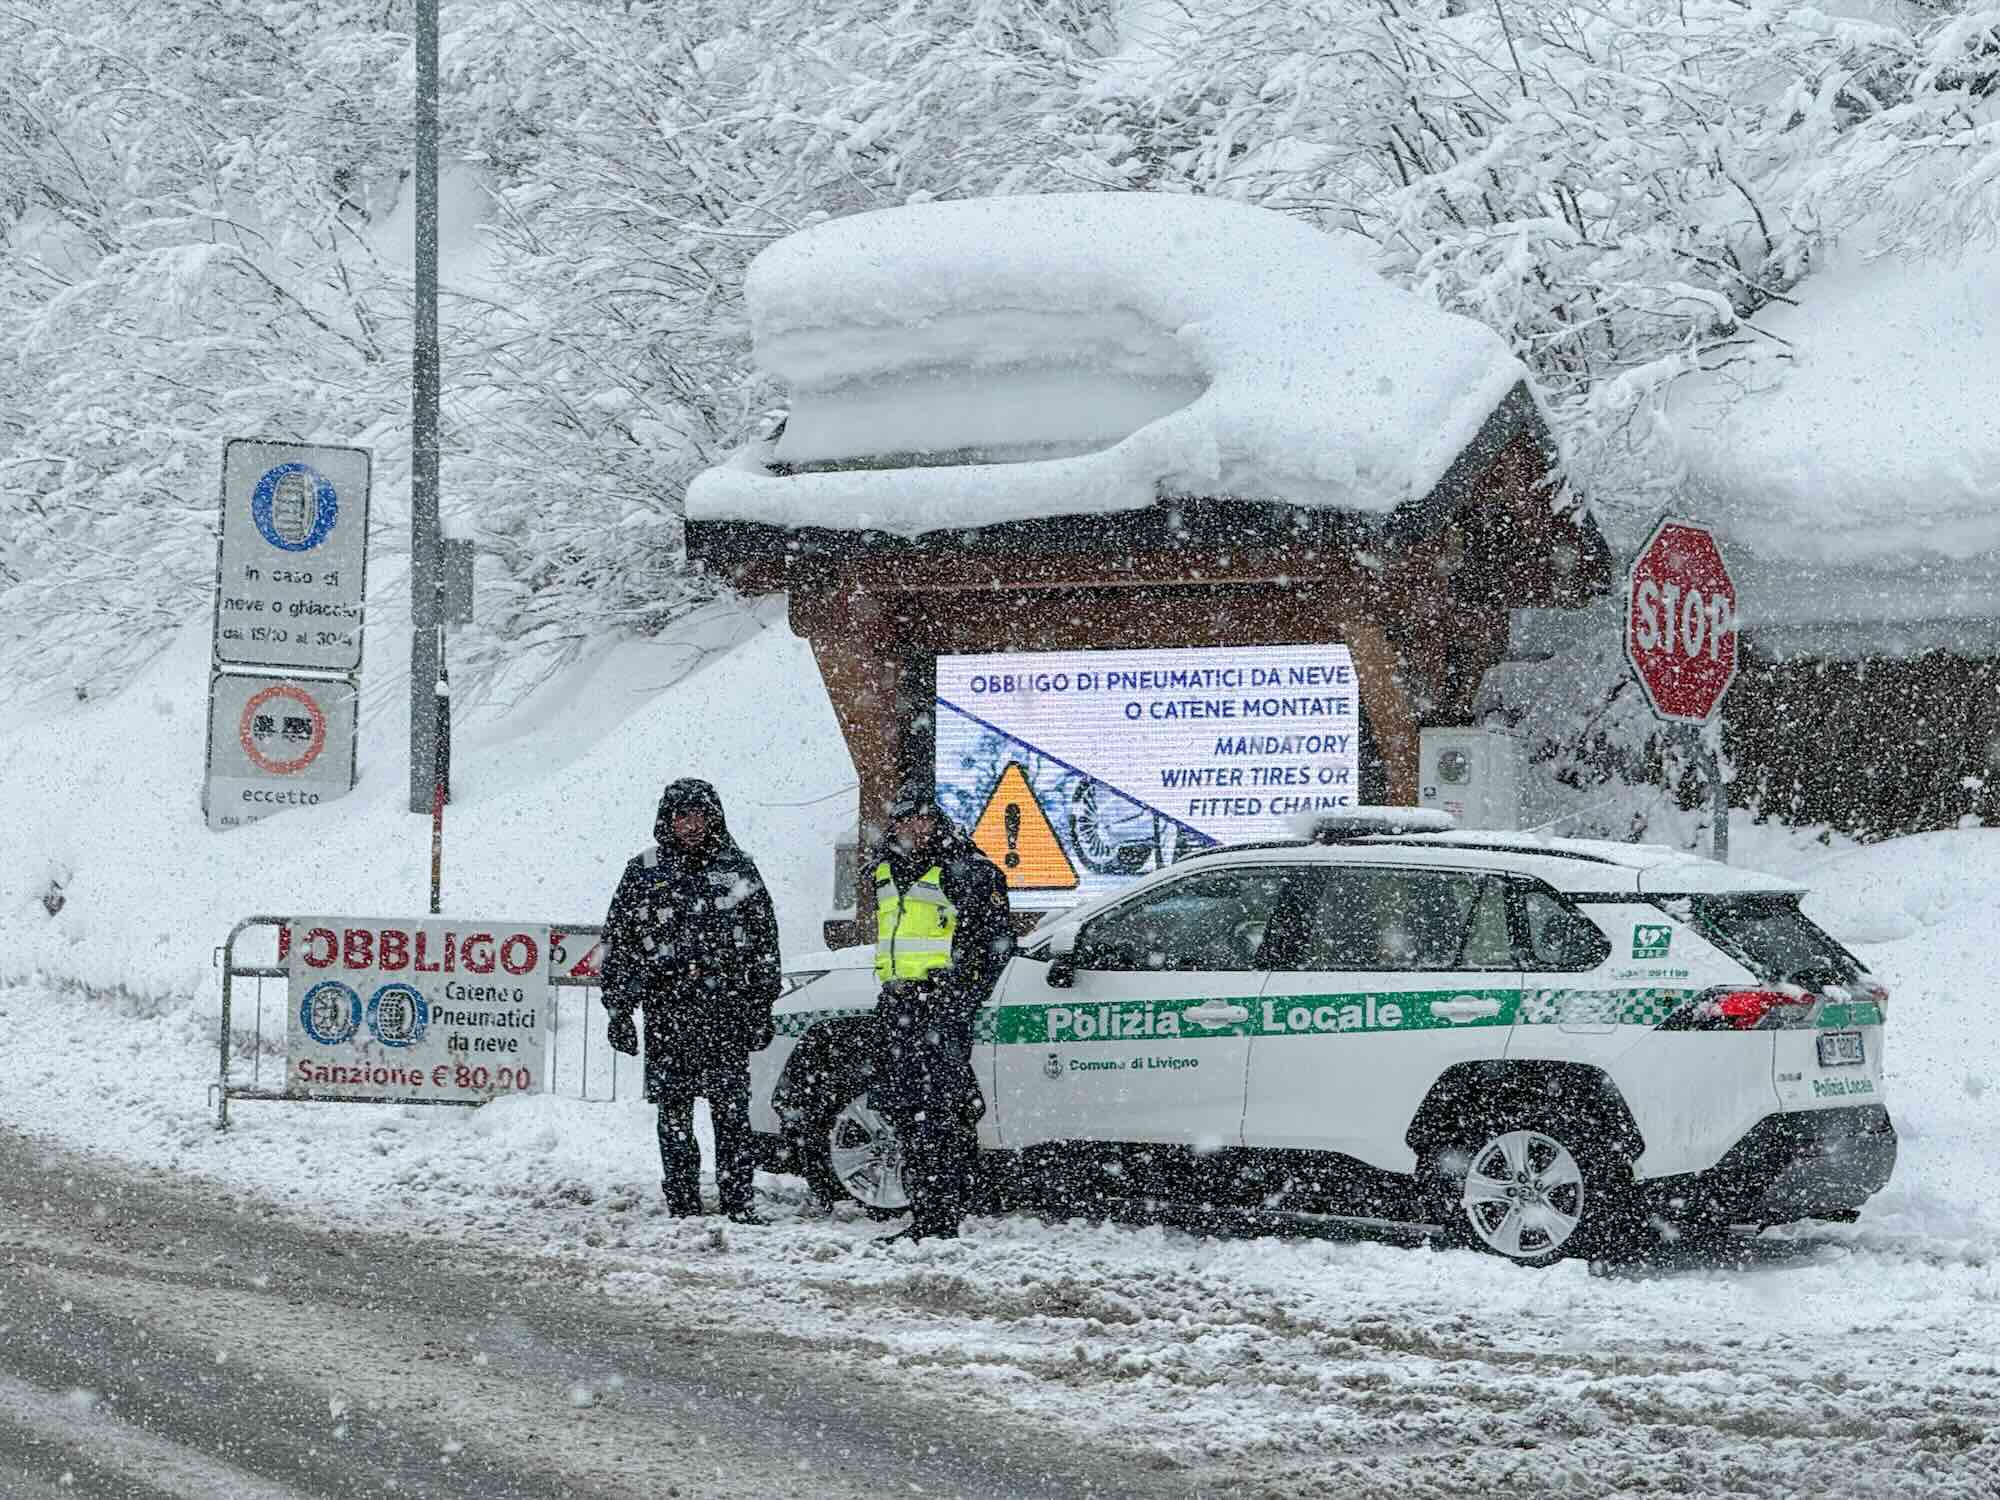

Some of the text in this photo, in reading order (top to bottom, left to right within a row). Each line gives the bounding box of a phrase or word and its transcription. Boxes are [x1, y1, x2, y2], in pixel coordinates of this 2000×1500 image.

[225, 598, 264, 611] neve
[272, 601, 283, 613] o
[1637, 580, 1730, 661] STOP
[970, 666, 1350, 694] OBBLIGO DI PNEUMATICI DA NEVE
[1125, 698, 1349, 720] O CATENE MONTATE
[1214, 736, 1349, 756] MANDATORY
[1161, 767, 1349, 787] WINTER TIRES OR
[241, 788, 320, 806] eccetto
[1189, 798, 1261, 816] FITTED
[303, 927, 538, 975] OBBLIGO
[446, 981, 524, 1003] Catene o
[432, 1005, 536, 1028] Pneumatici
[1047, 997, 1403, 1040] Polizia Locale
[448, 1032, 518, 1053] da neve
[1131, 1057, 1144, 1070] di
[1148, 1056, 1199, 1069] Livigno
[299, 1058, 531, 1091] Sanzione € 80,00
